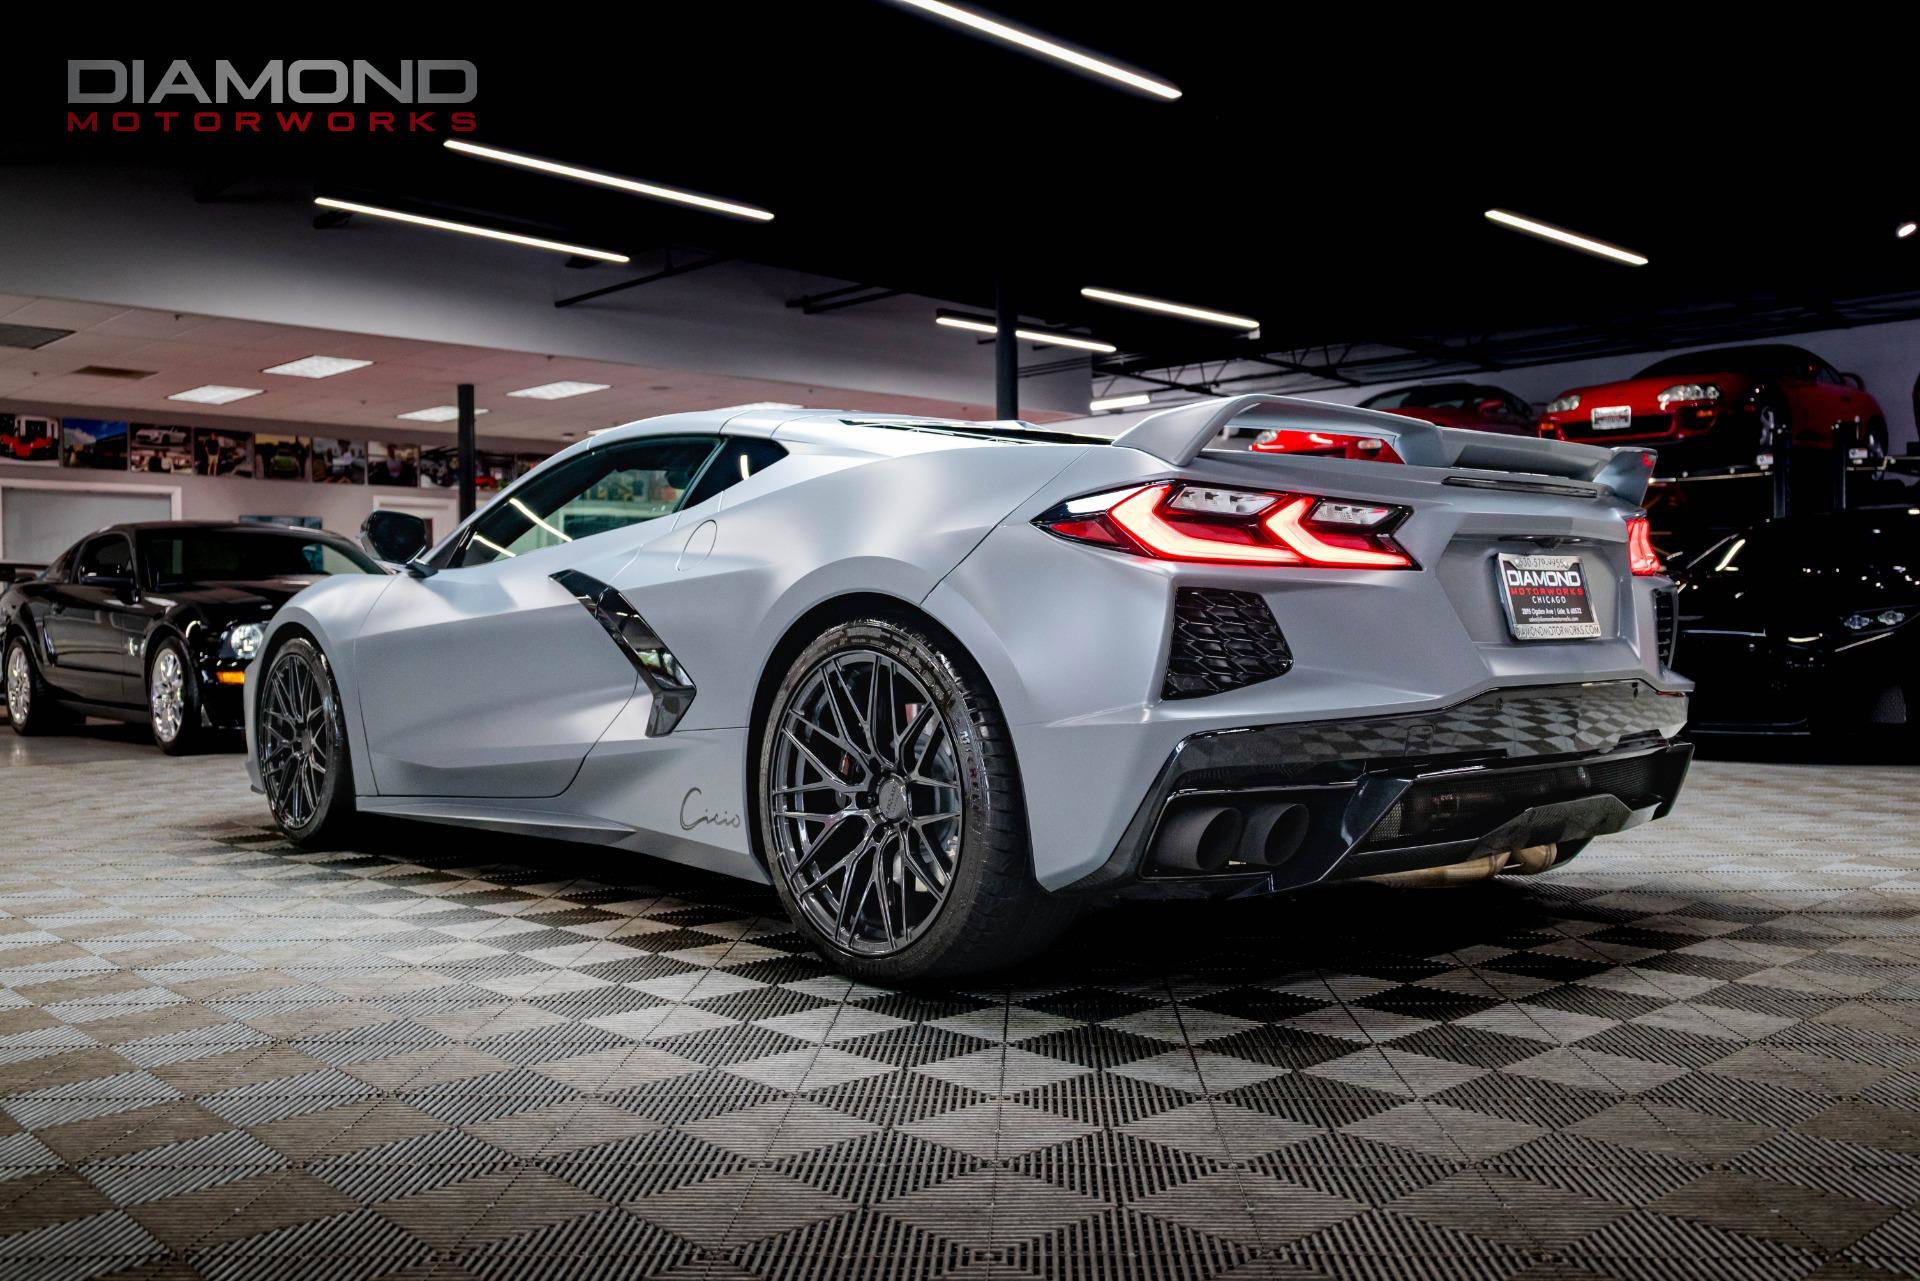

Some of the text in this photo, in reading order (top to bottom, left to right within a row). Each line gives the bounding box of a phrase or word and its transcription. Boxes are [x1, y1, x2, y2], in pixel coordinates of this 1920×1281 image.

[1506, 570, 1581, 587] DIAMOND
[1510, 587, 1584, 596] MOTORWORKS
[1532, 595, 1566, 604] CHICAGO
